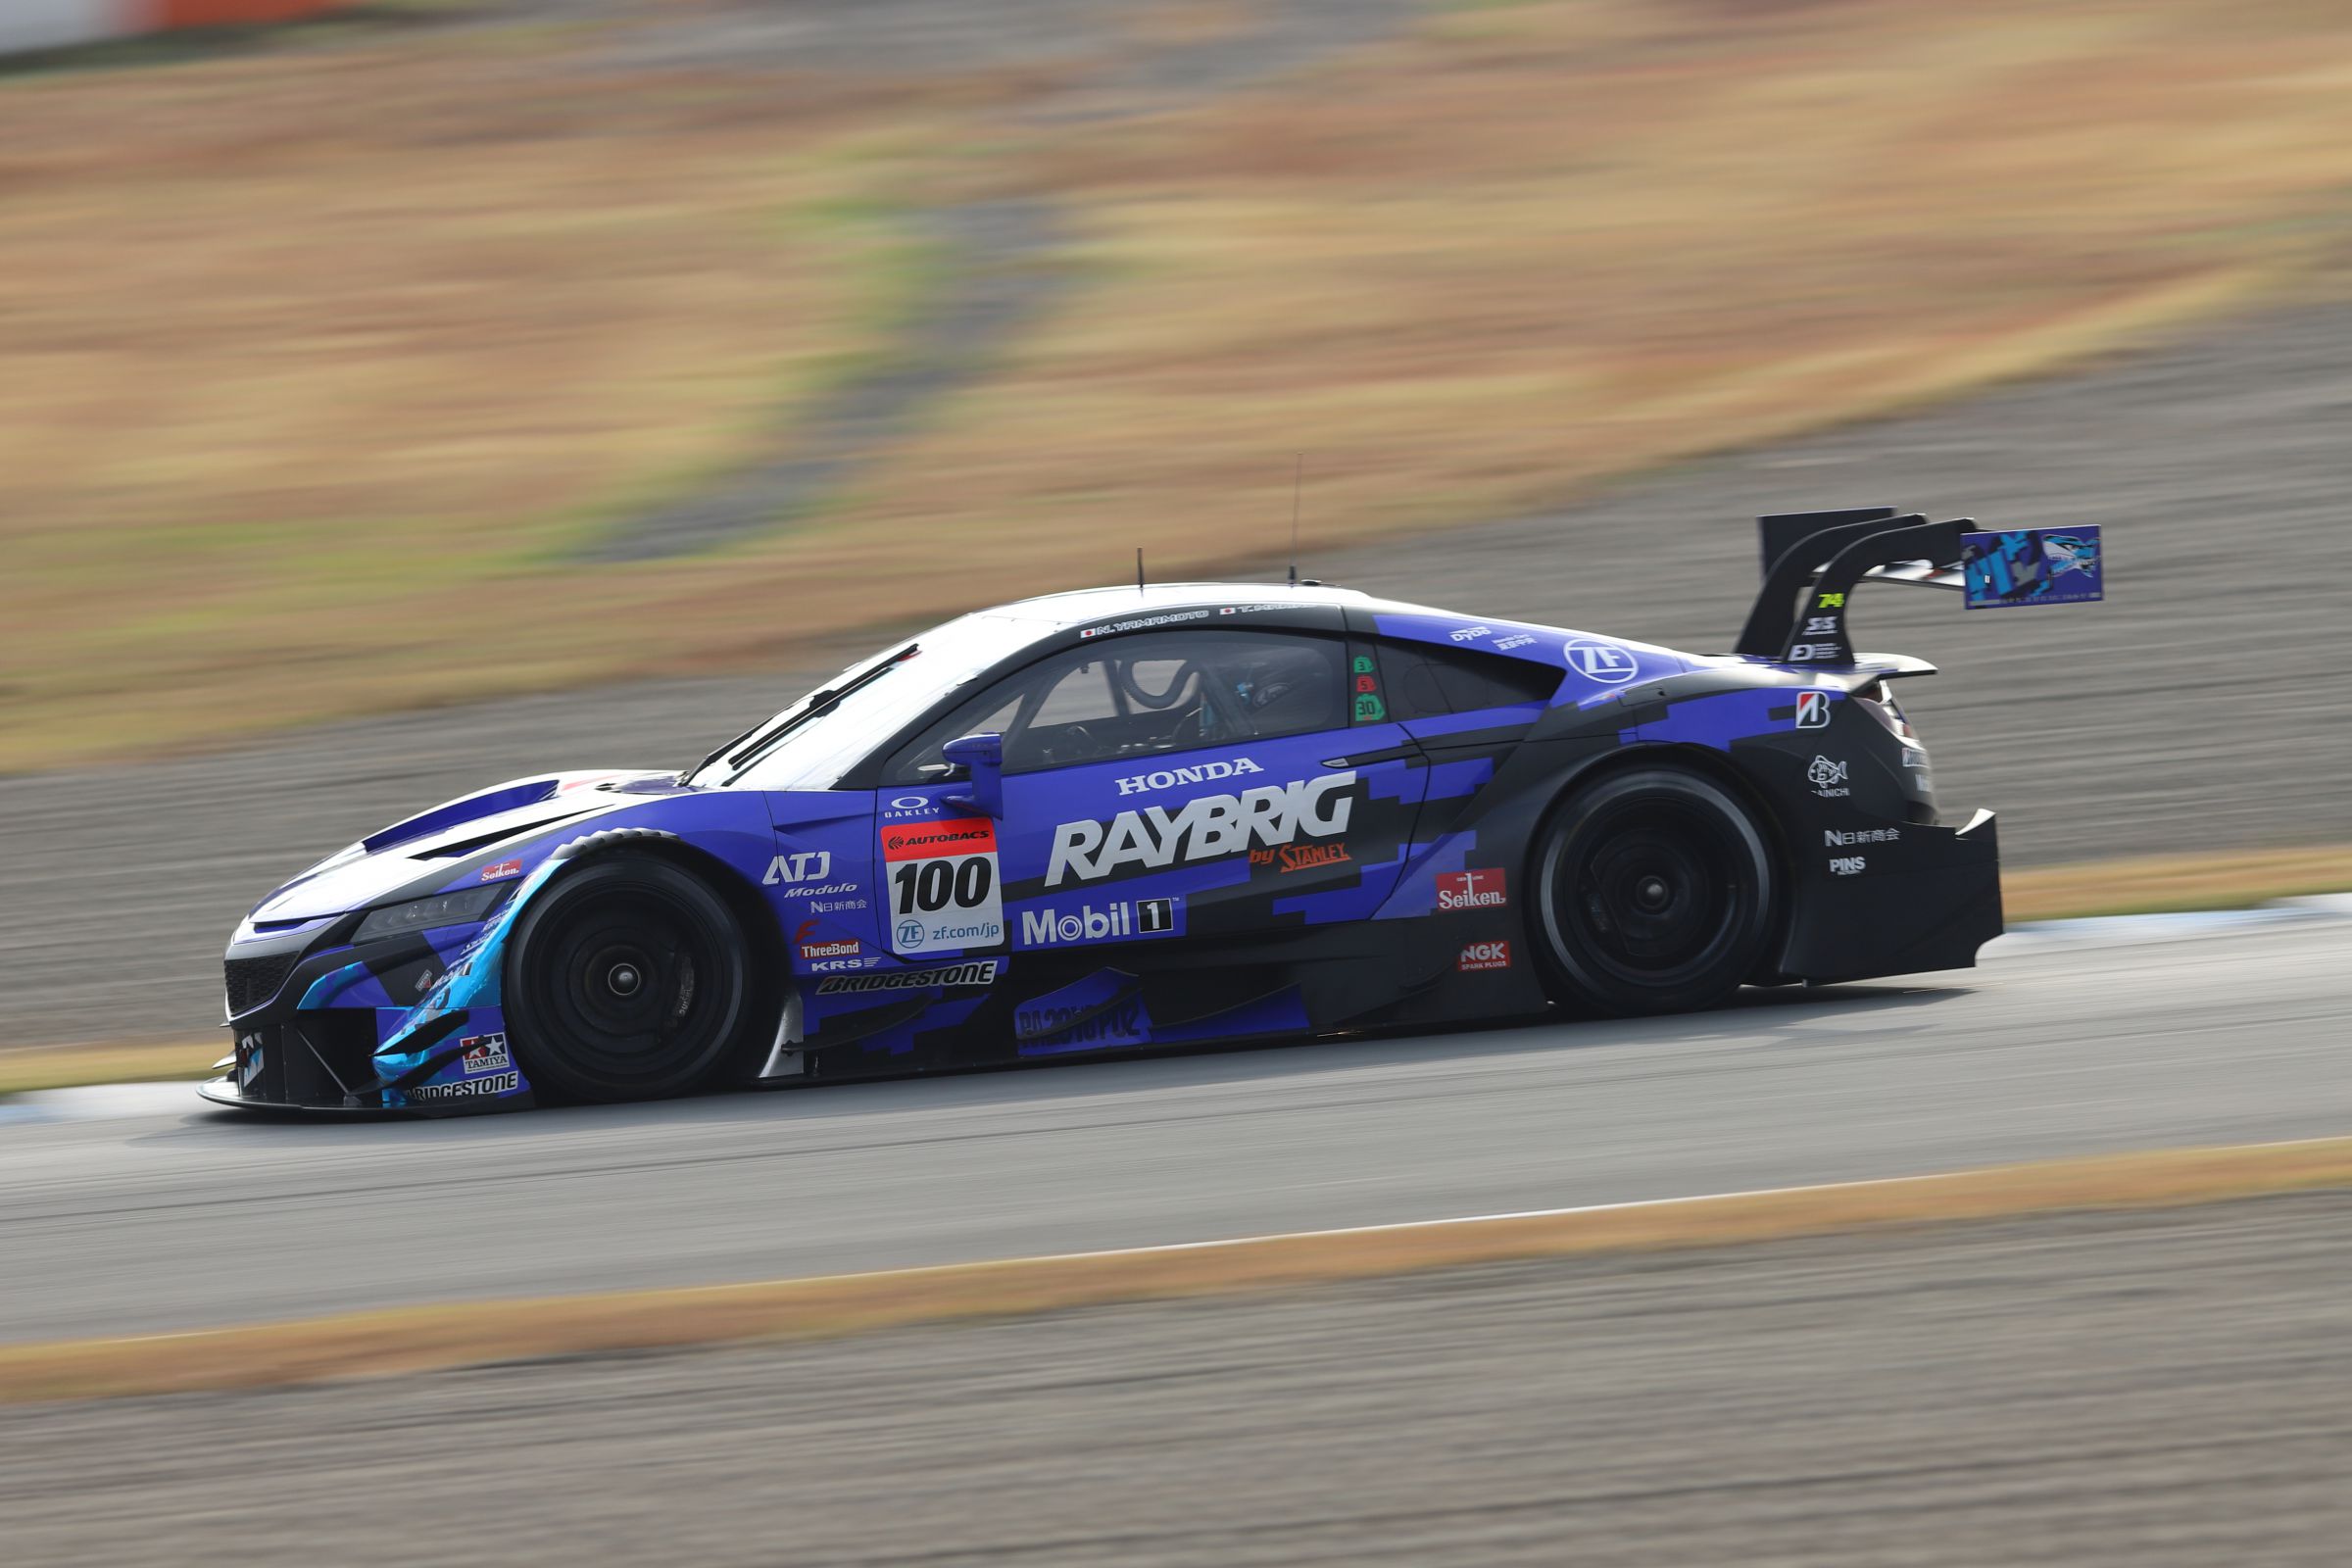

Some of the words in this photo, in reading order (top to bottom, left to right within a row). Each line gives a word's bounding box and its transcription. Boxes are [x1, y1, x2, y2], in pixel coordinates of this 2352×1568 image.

[1818, 592, 1844, 608] 74
[1114, 758, 1264, 796] HONDA
[1810, 787, 1850, 798] AINICHI
[884, 807, 940, 818] OAKLEY
[1044, 770, 1357, 887] RAYBRIG
[906, 830, 990, 846] AUTOBACS
[1249, 849, 1275, 865] by
[1278, 842, 1351, 873] STANLEY
[1829, 856, 1866, 872] PINS
[784, 882, 858, 899] Modulo
[895, 856, 992, 915] 100
[1439, 873, 1506, 909] Seiken
[933, 922, 1000, 940] zf.com/jp
[1021, 902, 1131, 946] Mobil
[802, 941, 859, 957] ThreeBond
[1460, 943, 1505, 962] NGK
[811, 958, 862, 972] KRS
[815, 960, 998, 995] BRIDGESTONE
[466, 1055, 508, 1069] TAMIYA
